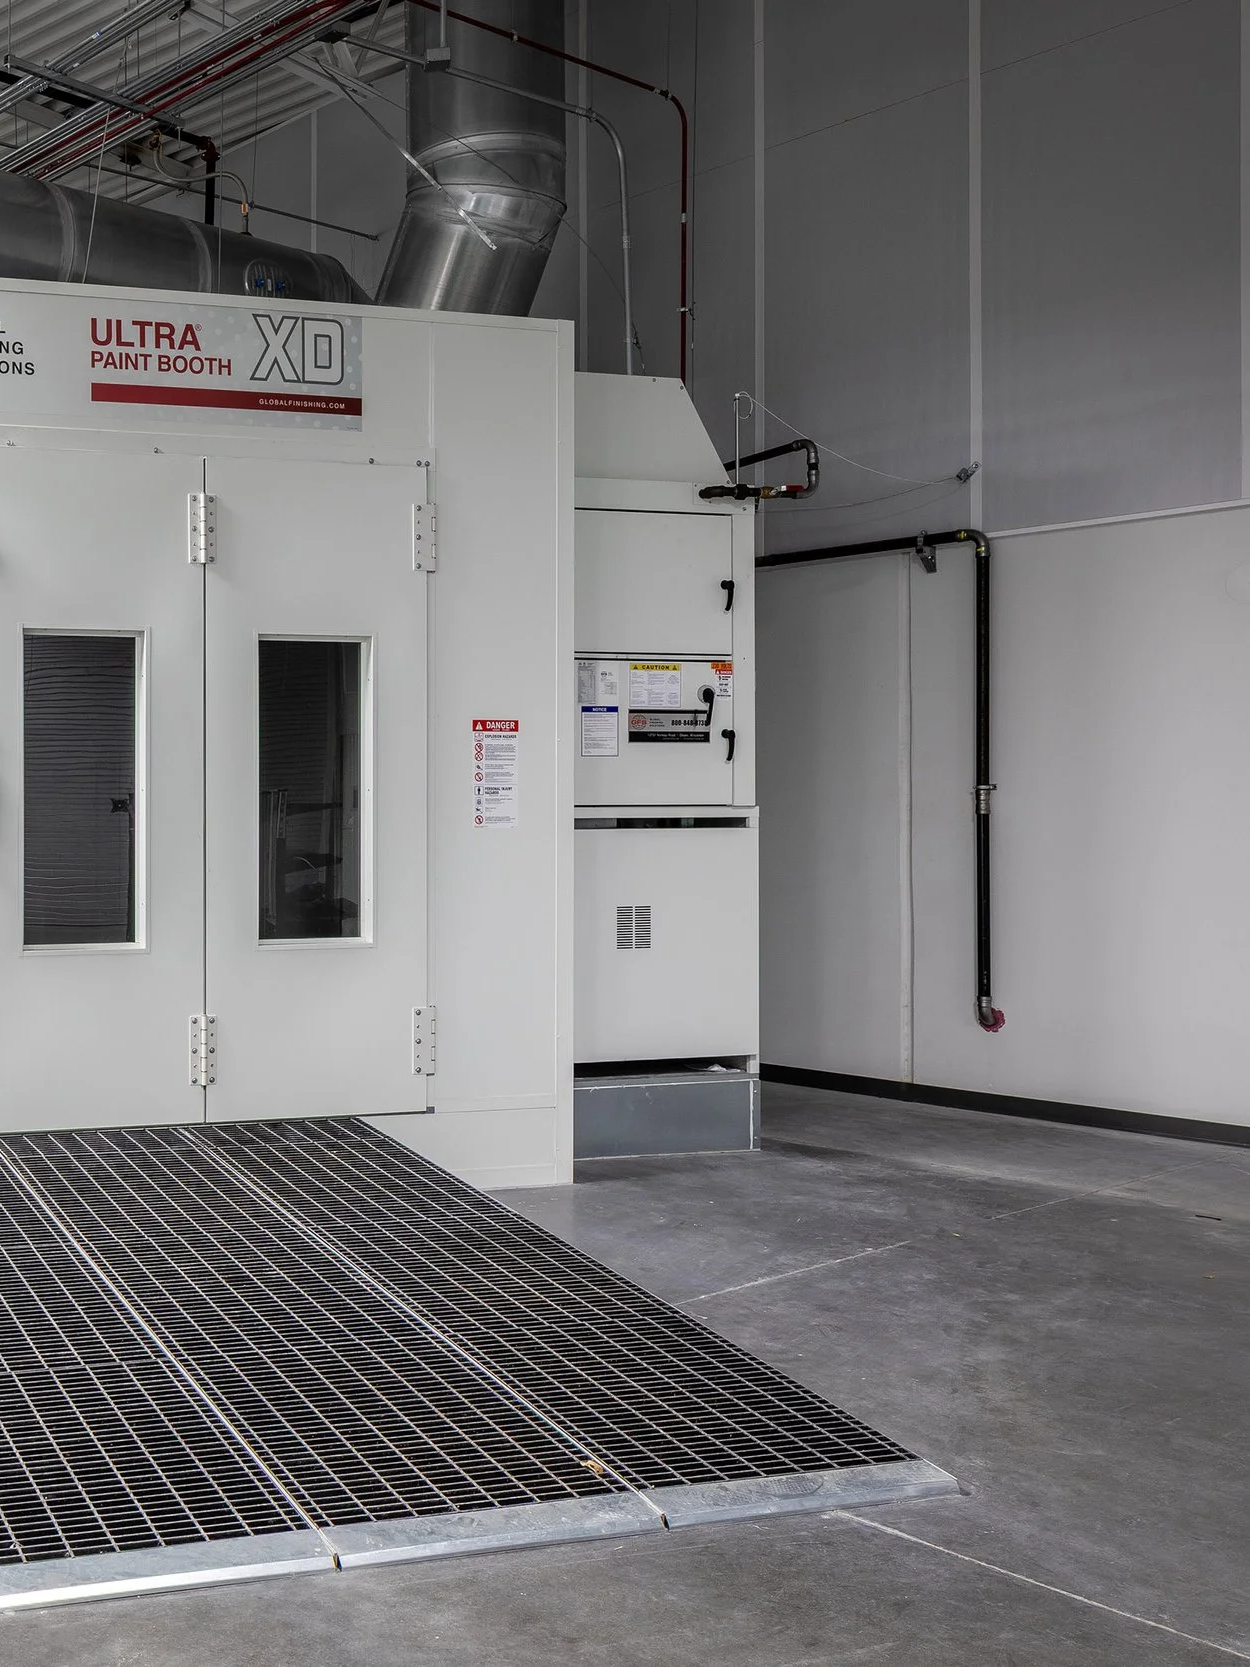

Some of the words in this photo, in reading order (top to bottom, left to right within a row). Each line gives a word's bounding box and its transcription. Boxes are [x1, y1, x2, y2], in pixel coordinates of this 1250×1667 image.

[90, 317, 201, 351] ULTRA
[249, 313, 345, 385] XD
[90, 350, 152, 371] PAINT
[157, 354, 232, 376] BOOTH
[258, 398, 346, 410] GLOBALFINISHING.COM
[486, 721, 516, 729] DANGER
